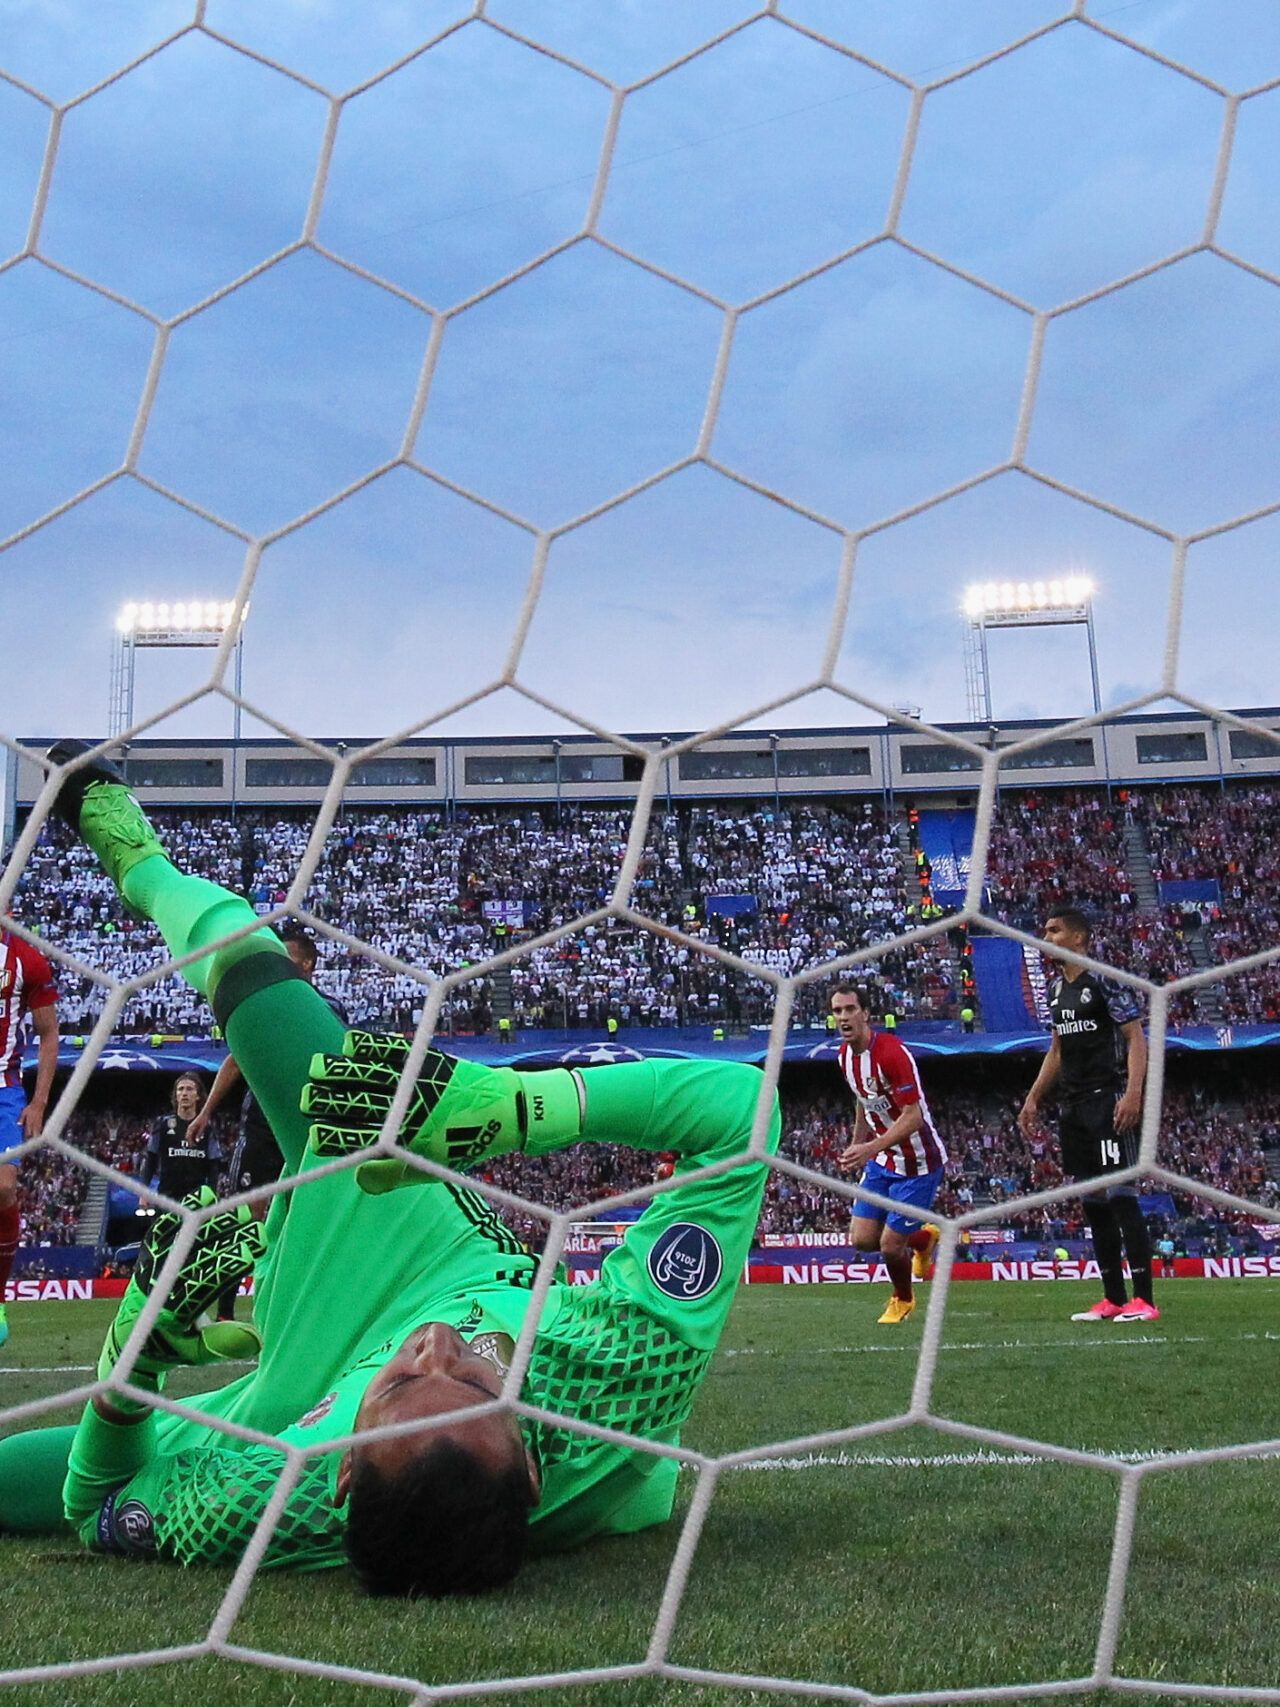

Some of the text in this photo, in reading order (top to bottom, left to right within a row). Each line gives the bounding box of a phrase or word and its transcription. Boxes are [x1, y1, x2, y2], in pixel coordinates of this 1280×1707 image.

[1056, 1019, 1098, 1036] mirates
[1100, 1139, 1120, 1166] 14
[674, 1250, 697, 1268] 2016
[783, 1263, 924, 1285] NISSA
